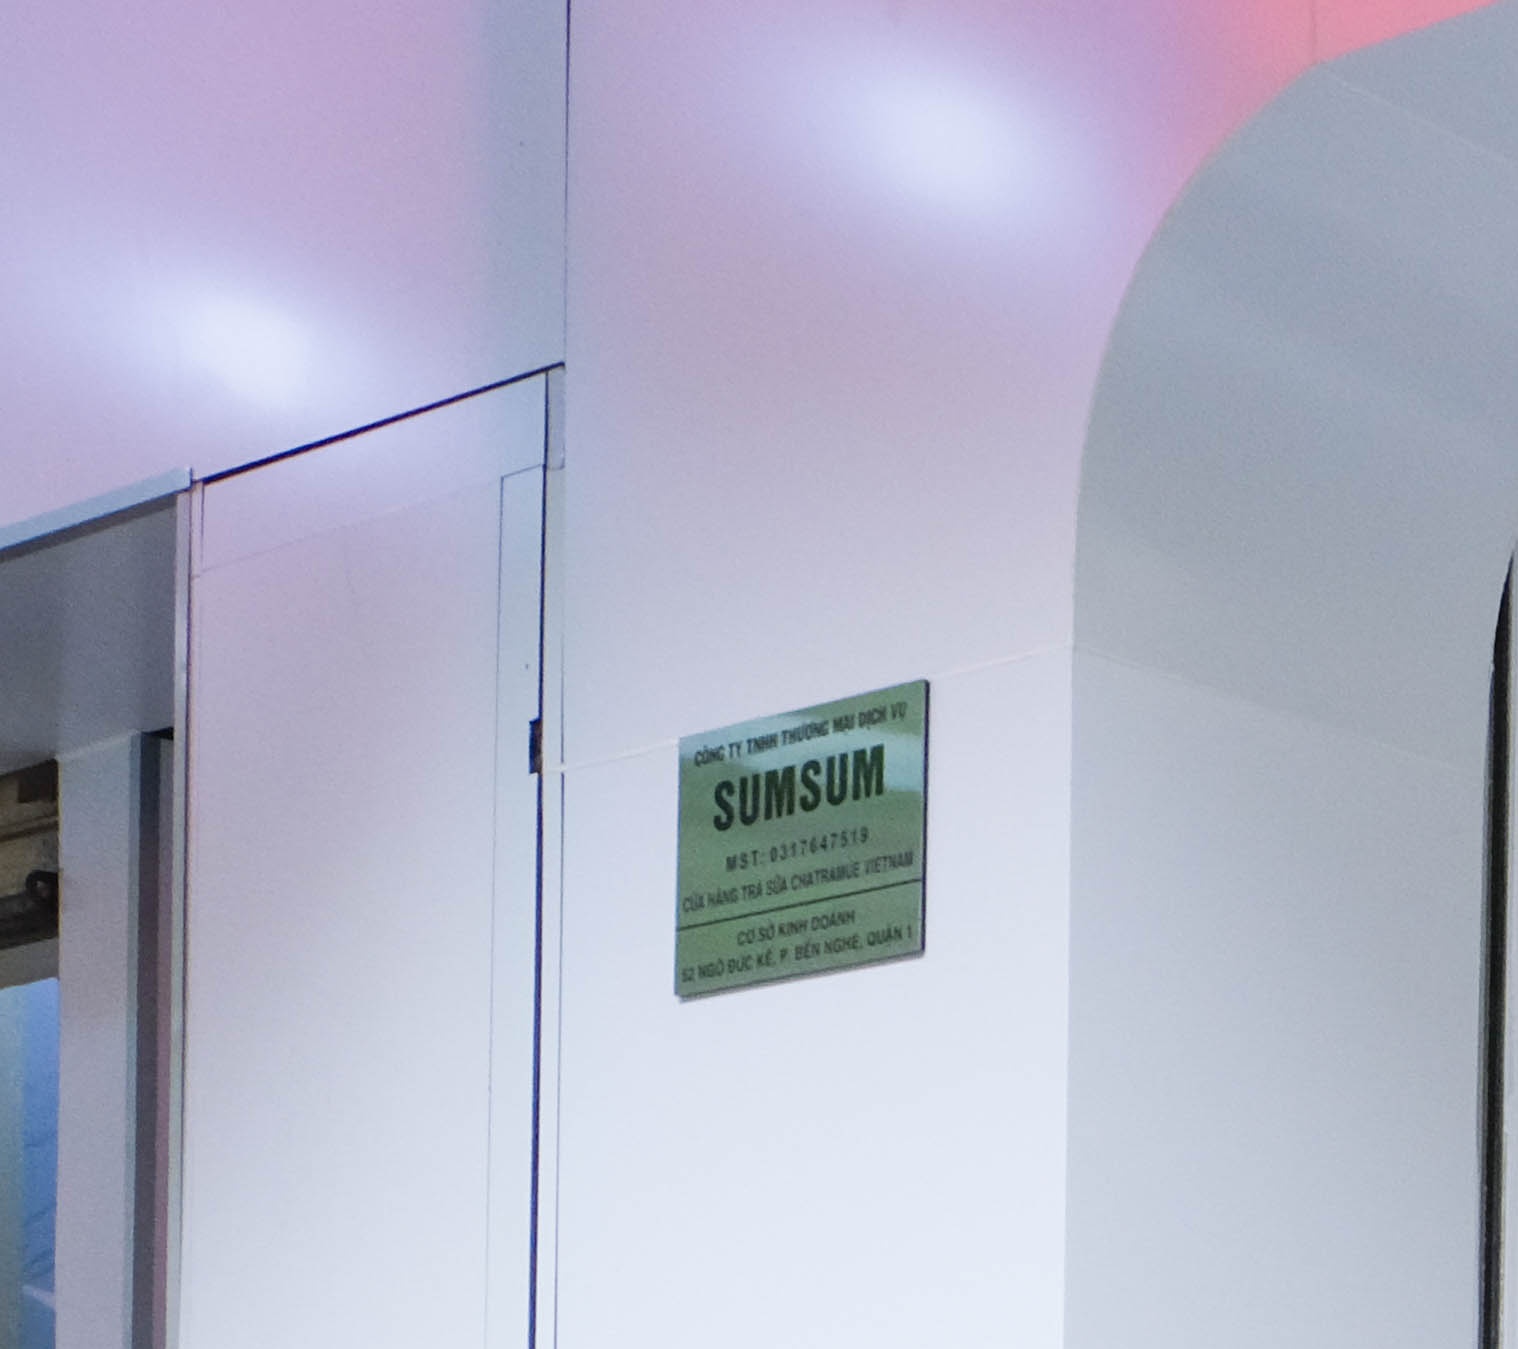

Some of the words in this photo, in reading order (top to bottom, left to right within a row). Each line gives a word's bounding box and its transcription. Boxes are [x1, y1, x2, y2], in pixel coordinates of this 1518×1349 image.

[728, 740, 744, 759] TY
[712, 743, 886, 831] SUMSUM
[725, 849, 766, 872] MST:
[778, 916, 809, 937] KINH
